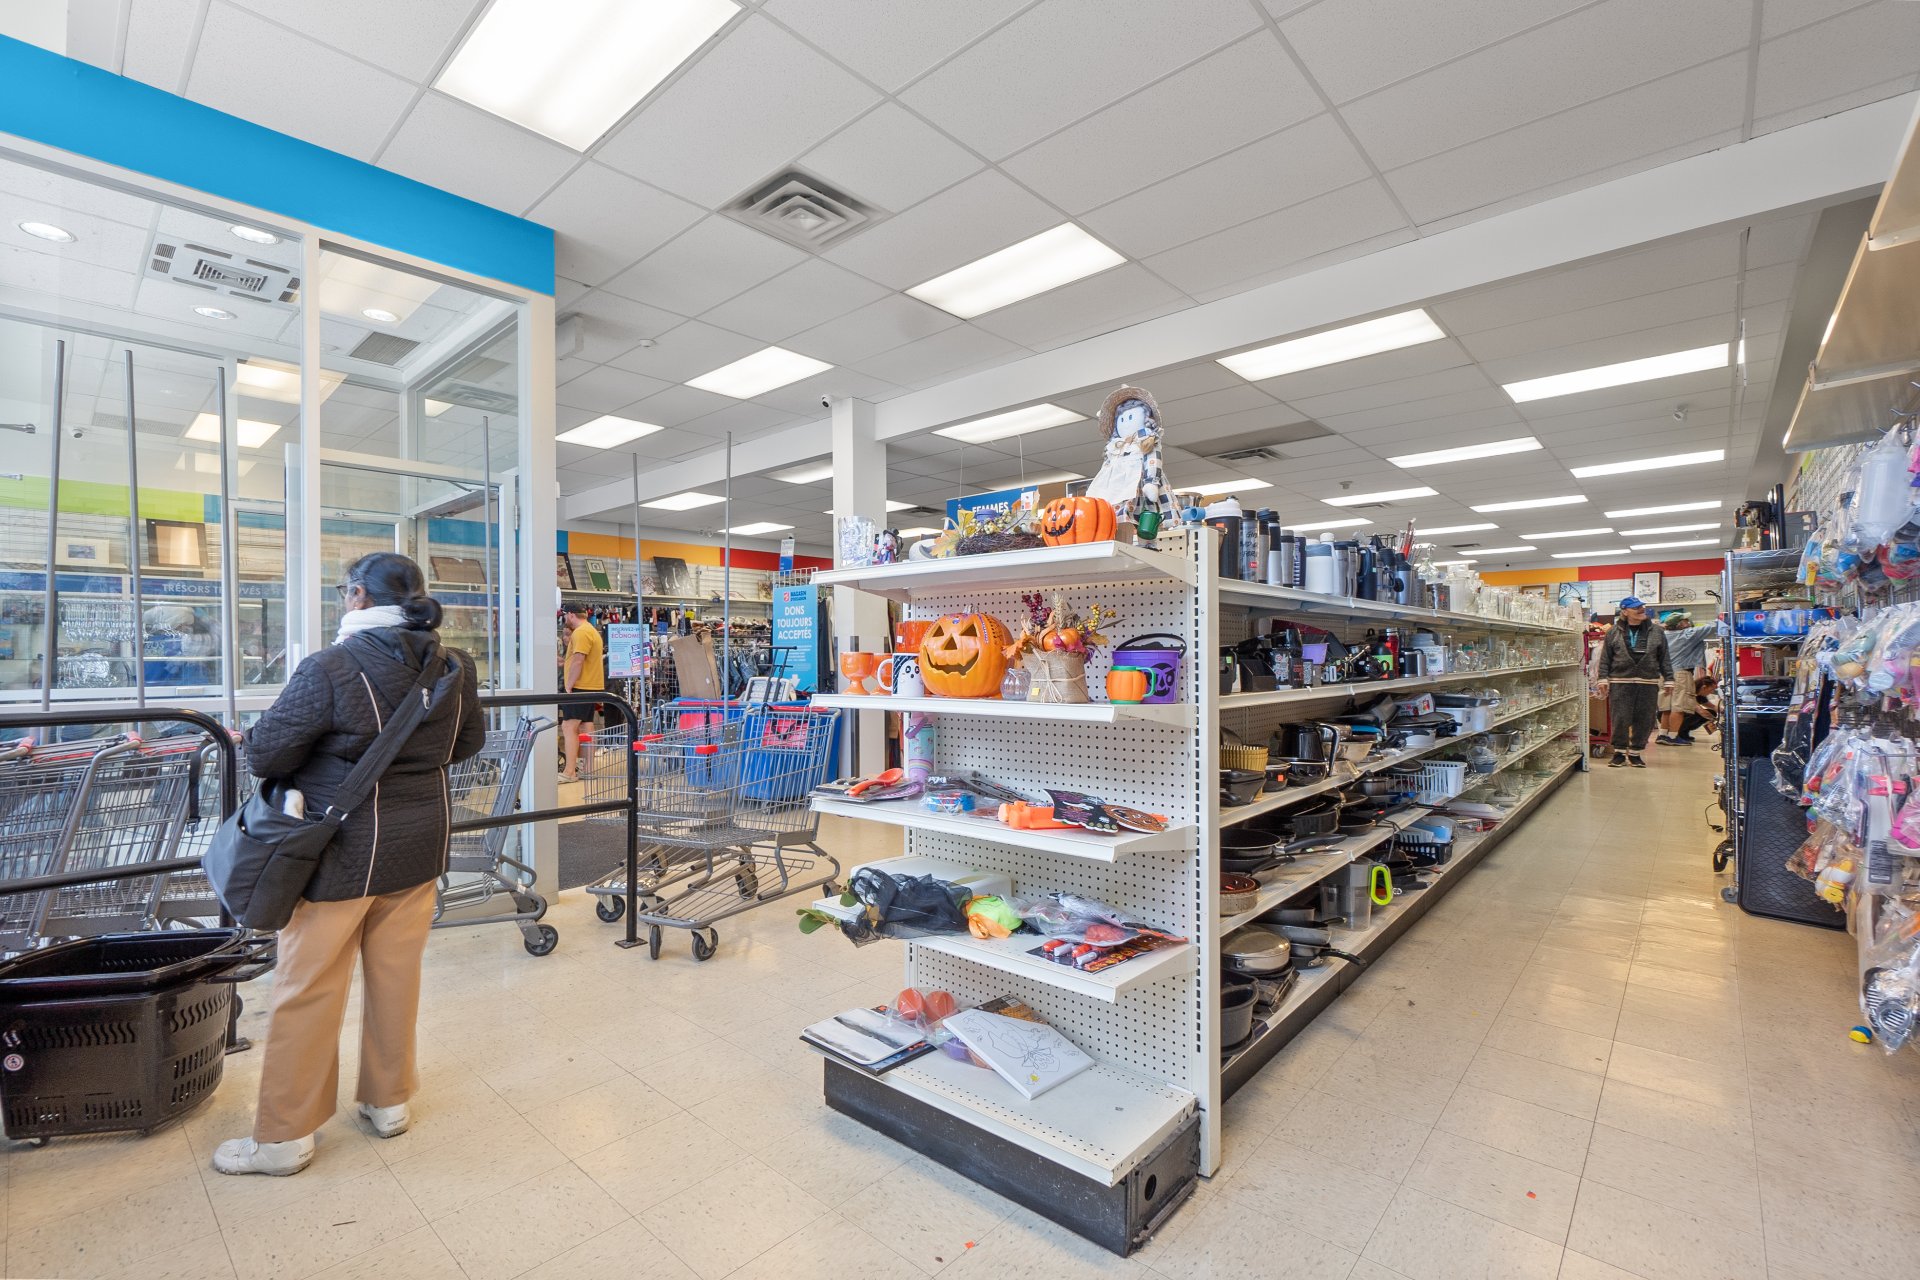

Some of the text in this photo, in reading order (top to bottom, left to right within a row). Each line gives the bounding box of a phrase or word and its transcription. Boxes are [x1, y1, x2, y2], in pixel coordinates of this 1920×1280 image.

[972, 501, 1009, 514] FEMMES
[162, 582, 210, 594] TRÉSORS
[784, 605, 805, 616] DONS
[777, 617, 813, 629] TOUJOURS
[777, 627, 813, 640] ACCEPTÉS
